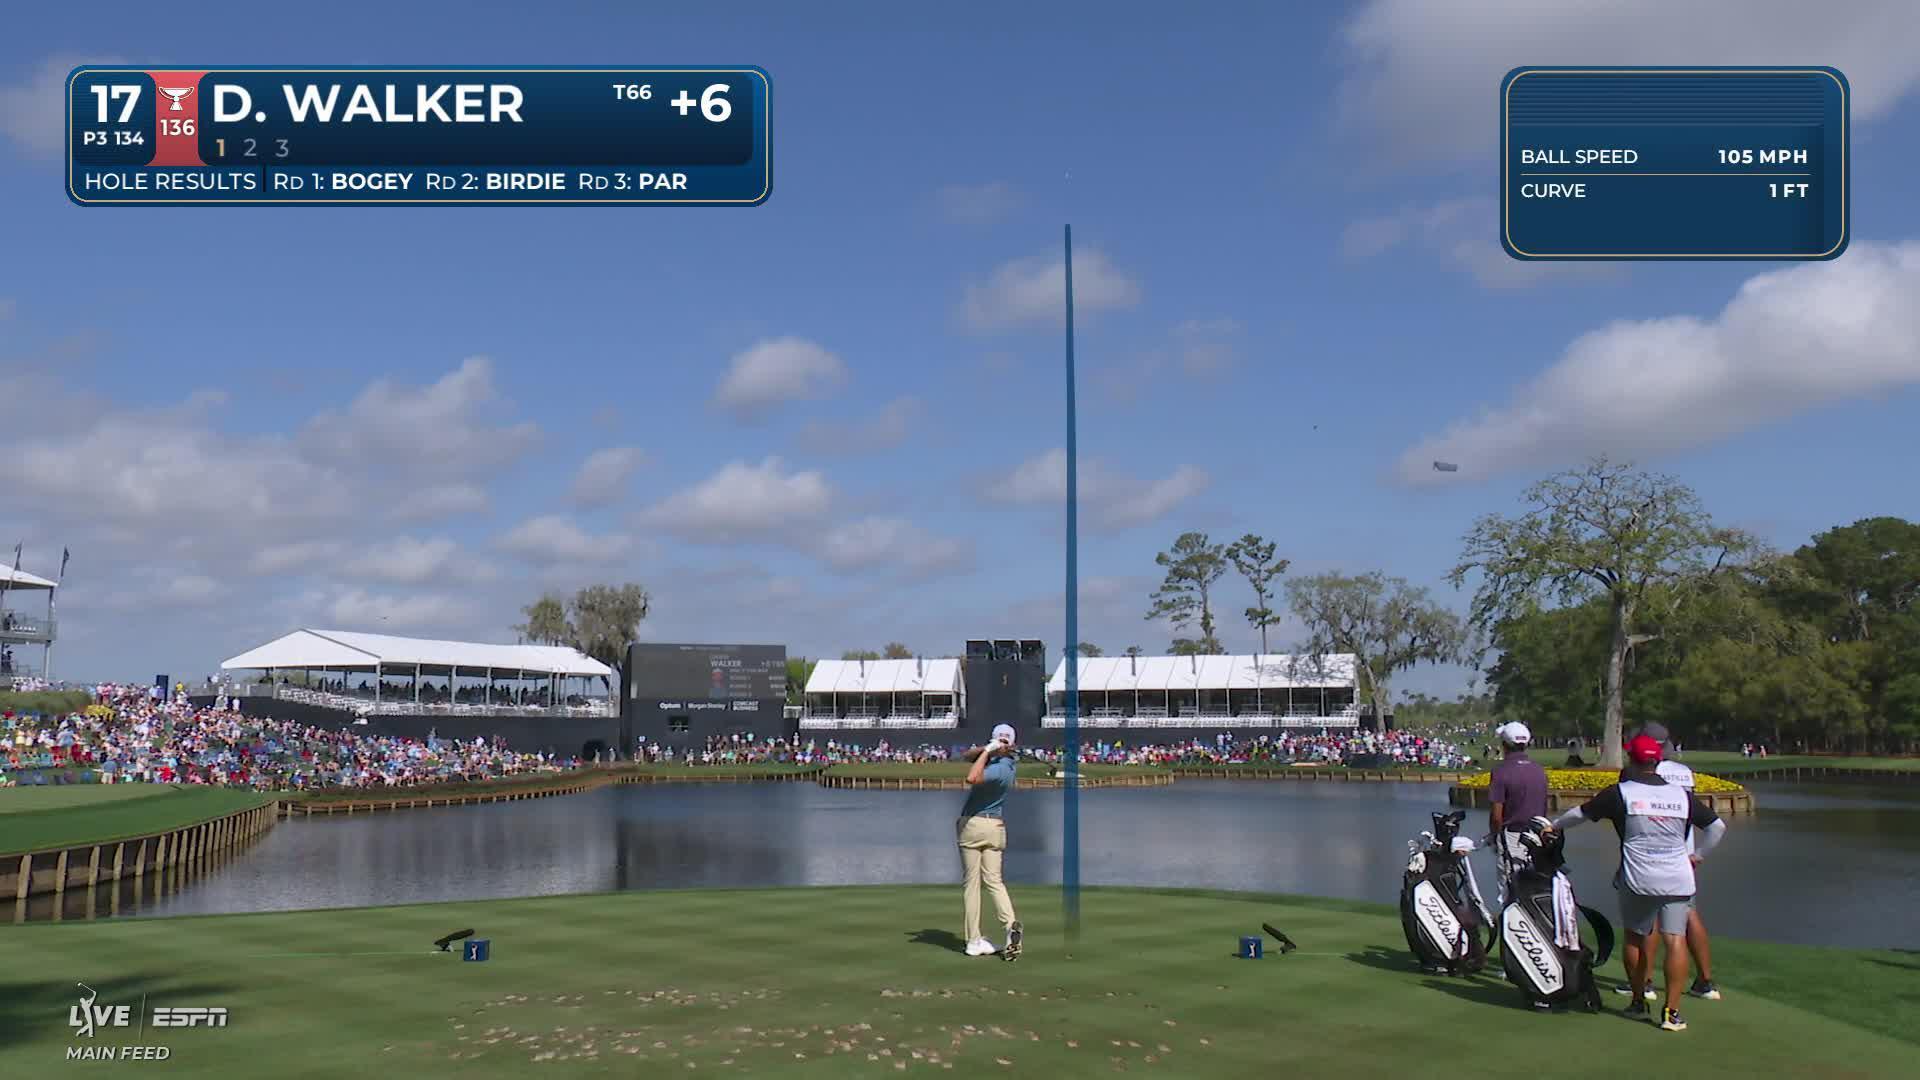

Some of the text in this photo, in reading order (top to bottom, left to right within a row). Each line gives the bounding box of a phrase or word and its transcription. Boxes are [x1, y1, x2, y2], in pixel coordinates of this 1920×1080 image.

[659, 702, 682, 711] Optum
[1650, 802, 1682, 812] WALKER
[1507, 920, 1557, 984] Titleist
